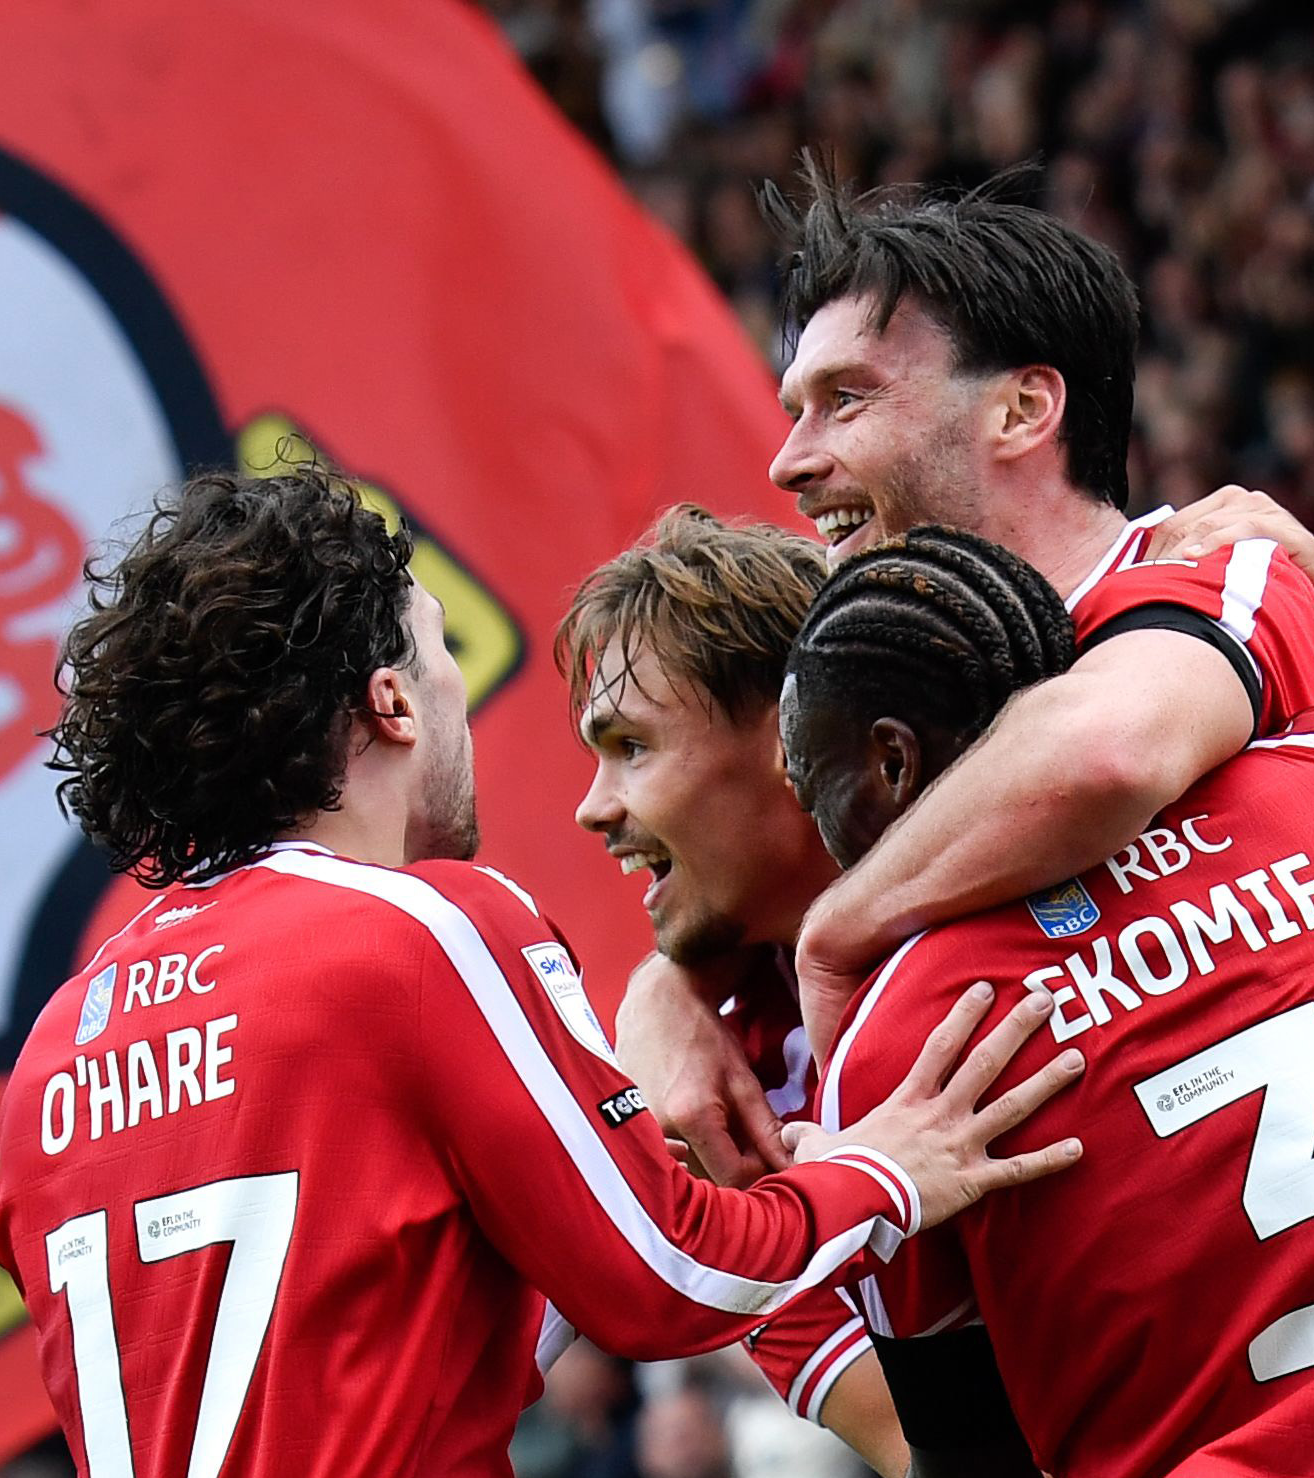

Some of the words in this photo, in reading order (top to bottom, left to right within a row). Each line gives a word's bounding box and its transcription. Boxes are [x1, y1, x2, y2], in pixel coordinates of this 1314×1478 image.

[1105, 814, 1233, 894] RBC
[1050, 906, 1097, 936] RBC
[123, 944, 226, 1014] RBC
[540, 955, 566, 975] sky
[80, 1014, 107, 1041] RBC
[40, 1013, 239, 1156] O'HARE
[1172, 1082, 1191, 1097] EFL
[1190, 1075, 1203, 1088] IN
[1202, 1065, 1222, 1081] THE
[1177, 1069, 1235, 1106] COMMUNITY
